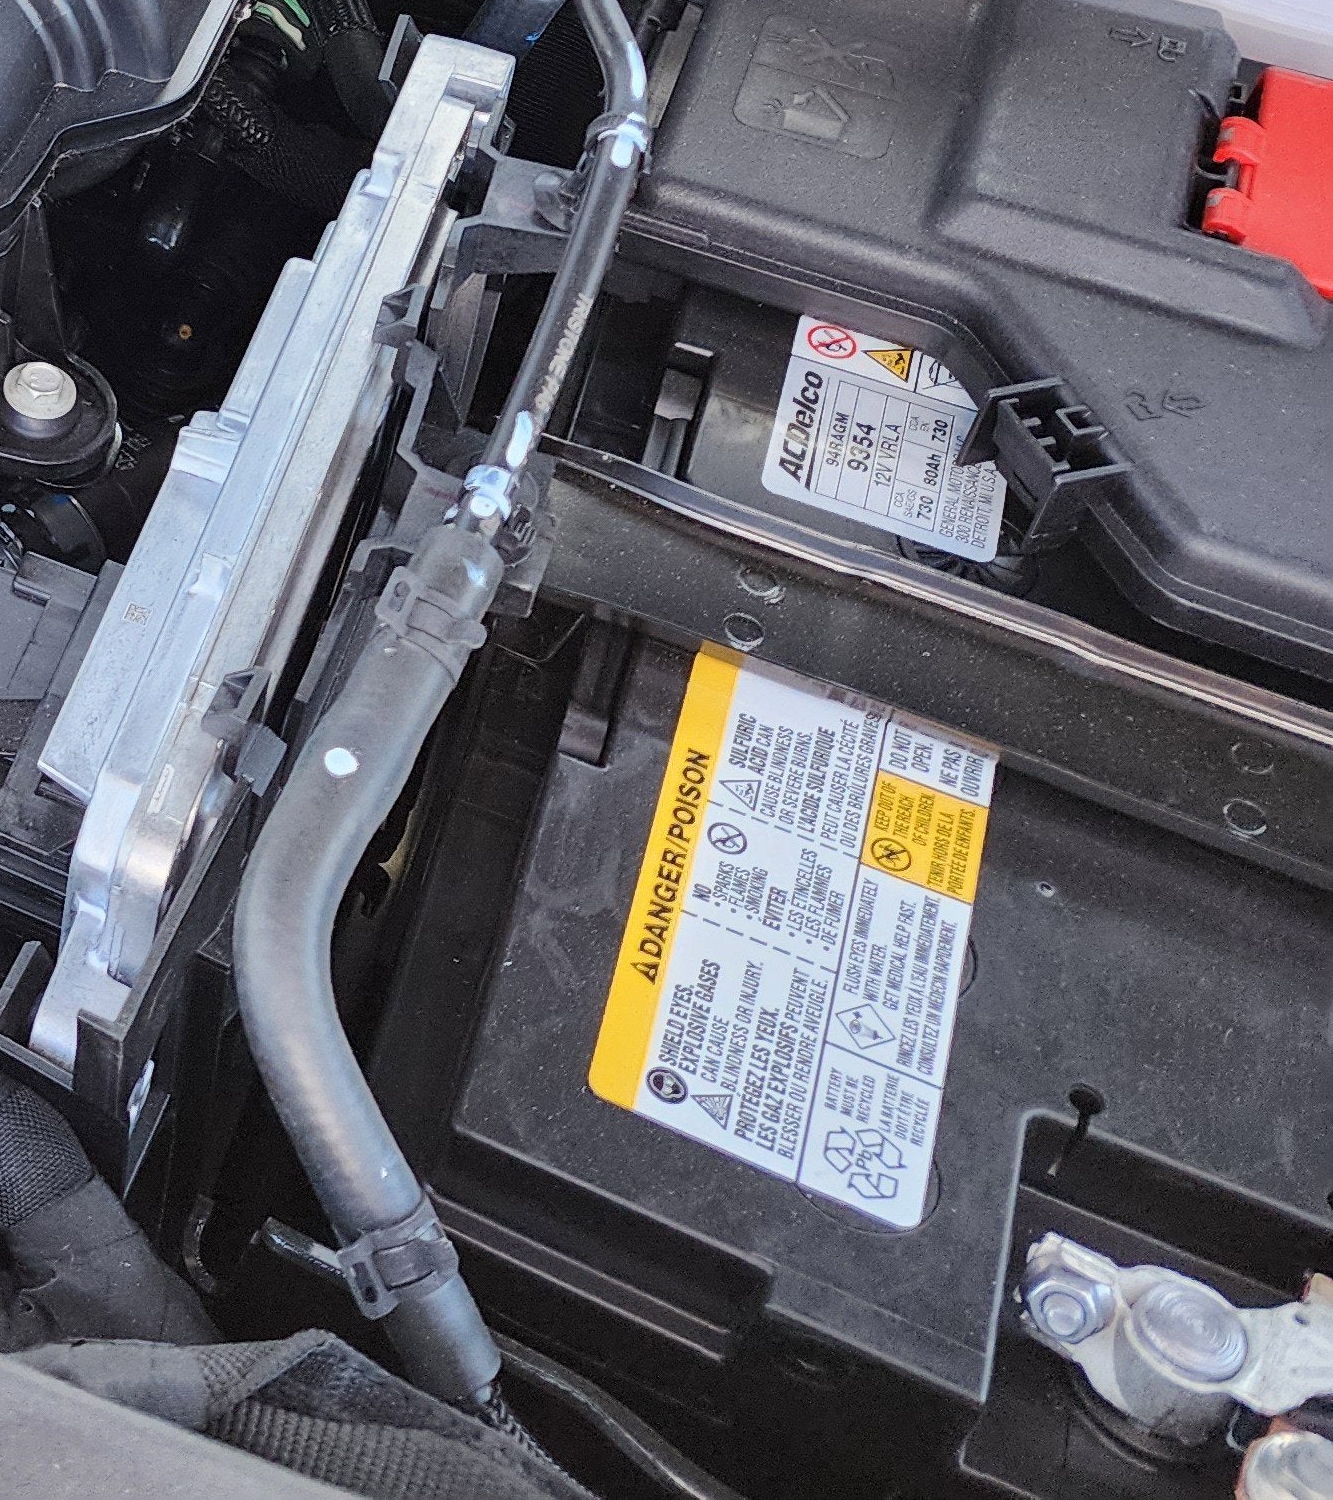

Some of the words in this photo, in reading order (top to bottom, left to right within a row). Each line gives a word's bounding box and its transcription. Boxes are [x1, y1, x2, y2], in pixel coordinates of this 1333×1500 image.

[779, 371, 822, 481] ACDelco
[825, 411, 849, 466] 94RAGM
[878, 424, 901, 458] VRLA
[931, 419, 947, 442] 730
[847, 422, 876, 471] 9354
[874, 462, 892, 486] 12V
[923, 453, 941, 486] 80Ah
[916, 495, 933, 520] 730
[938, 496, 959, 537] GENERAL
[954, 524, 970, 543] 300
[728, 713, 755, 768] SULFURIC
[755, 723, 773, 747] CAN
[790, 732, 812, 768] BURNS.
[834, 718, 859, 755] CÉCITÉ
[891, 728, 912, 753] NOT
[747, 746, 768, 775] ACID
[767, 725, 793, 784] BLINDNESS
[806, 726, 835, 792] SULFURIQUE
[834, 756, 852, 771] LA
[888, 751, 908, 770] DO
[911, 742, 933, 772] OPEN.
[941, 748, 961, 771] PAS
[781, 767, 804, 808] SEVERE
[826, 770, 848, 812] CAUSER
[846, 753, 872, 810] BRÛLURES
[880, 780, 896, 794] OF
[938, 769, 958, 788] NE
[759, 782, 780, 817] CAUSE
[778, 807, 795, 825] OR
[797, 791, 821, 833] L'ACIDE
[877, 791, 894, 811] OUT
[895, 794, 913, 823] REACH
[914, 792, 934, 834] CHILDREN.
[820, 811, 839, 841] PEUT
[842, 809, 860, 831] DES
[873, 809, 890, 832] KEEP
[892, 820, 909, 838] THE
[936, 822, 952, 837] DE
[937, 811, 954, 825] LA
[955, 808, 975, 849] ENFANTS.
[639, 749, 708, 958] DANGER/POISON
[839, 830, 856, 848] OU
[911, 832, 926, 846] OF
[932, 836, 949, 861] HORS
[952, 847, 968, 861] DE
[712, 861, 734, 901] SPARKS
[728, 866, 750, 907] FLAMES
[744, 866, 767, 913] SMOKING
[787, 848, 817, 909] ÉTINCELLES
[808, 864, 832, 916] FLAMMES
[926, 860, 944, 887] TENIR
[946, 859, 966, 895] PORTÉE
[692, 883, 711, 902] NO
[758, 886, 787, 930] ÉVITER
[823, 890, 844, 928] FUMER
[853, 878, 877, 939] IMMEDIATELY
[786, 909, 804, 931] LES
[803, 916, 821, 938] LES
[897, 899, 916, 925] FAST.
[820, 927, 837, 945] DE
[893, 924, 910, 950] HELP
[914, 895, 939, 964] IMMÉDIATEMENT.
[848, 938, 867, 963] EYES
[867, 943, 887, 976] WATER.
[933, 920, 956, 975] RAPIDEMENT.
[739, 960, 763, 1005] INJURY.
[842, 962, 861, 995] FLUSH
[885, 951, 906, 991] MEDICAL
[910, 962, 928, 988] L'EAU
[669, 984, 694, 1019] EYES.
[784, 967, 809, 1022] PEUVENT
[862, 975, 880, 1002] WITH
[882, 990, 899, 1010] GET
[905, 993, 922, 1017] YEUX
[925, 973, 947, 1012] MÉDECIN
[678, 1001, 710, 1074] EXPLOSIVE
[694, 958, 719, 1002] GASES
[735, 1005, 752, 1023] OR
[803, 979, 827, 1034] AVEUGLE.
[925, 1010, 940, 1025] UN
[706, 1015, 729, 1056] CAUSE
[754, 1007, 779, 1043] YEUX.
[901, 1017, 919, 1035] LES
[658, 1018, 684, 1066] SHIELD
[720, 1024, 748, 1091] BLINDNESS
[748, 1044, 770, 1071] LES
[767, 1021, 797, 1094] EXPLOSIFS
[792, 1032, 816, 1083] RENDRE
[896, 1033, 916, 1067] RINCEZ
[916, 1024, 939, 1075] CONSULTEZ
[700, 1055, 720, 1083] CAN
[845, 1075, 858, 1088] BE
[788, 1081, 806, 1102] OU
[824, 1067, 841, 1110] BATTERY
[840, 1088, 855, 1117] MUST
[856, 1075, 875, 1123] RECYCLED
[880, 1073, 899, 1118] BATTERIE
[734, 1070, 765, 1141] PROTÉGEZ
[761, 1093, 783, 1123] GAZ
[755, 1123, 777, 1151] LES
[777, 1102, 802, 1159] BLESSER
[878, 1119, 891, 1132] LA
[894, 1114, 908, 1139] DOIT
[855, 1149, 872, 1171] Pb
